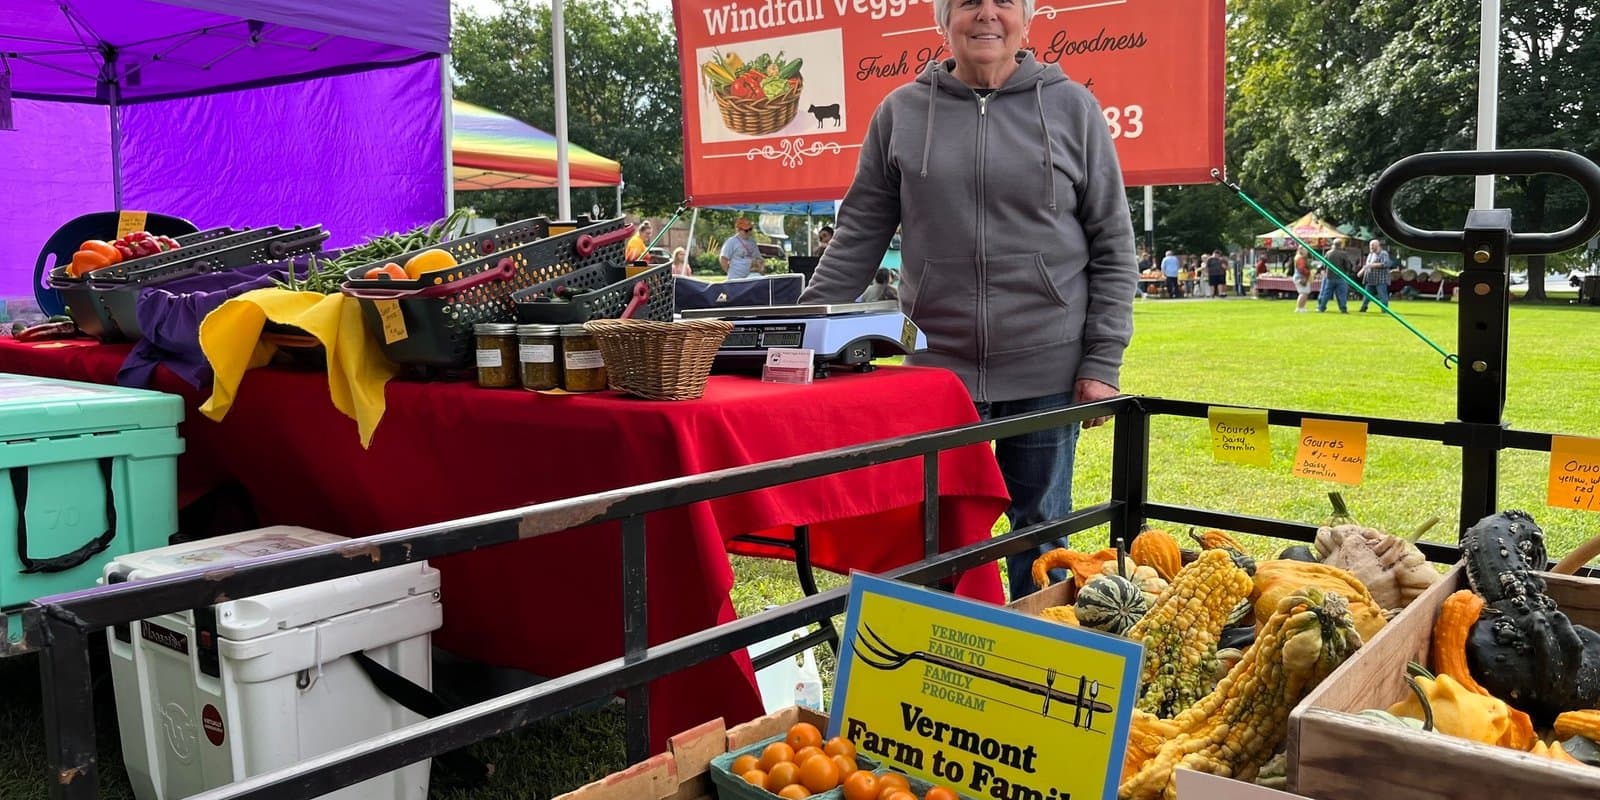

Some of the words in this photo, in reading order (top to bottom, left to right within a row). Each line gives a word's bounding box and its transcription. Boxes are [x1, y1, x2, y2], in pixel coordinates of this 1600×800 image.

[703, 0, 825, 36] Windfall
[834, 0, 933, 20] Vegg
[856, 50, 909, 81] Fresh
[1044, 27, 1147, 63] Goodness
[1215, 422, 1256, 435] Gourds
[1222, 435, 1245, 444] Daisy
[1302, 435, 1344, 449] Gourds
[1222, 443, 1255, 451] Gremlin
[1303, 460, 1327, 471] Daisy
[1342, 455, 1362, 464] each
[1302, 468, 1337, 478] Gremlin
[1558, 475, 1588, 486] yellow,
[1575, 485, 1594, 493] red
[1573, 495, 1581, 505] 4
[931, 624, 997, 652] VERMONT
[928, 640, 964, 662] FARM
[968, 651, 985, 668] TO
[924, 665, 974, 690] FAMILY
[920, 682, 986, 712] PROGRAM
[900, 702, 1038, 773] Vermont
[847, 717, 924, 771] Farm
[931, 750, 963, 787] to
[968, 760, 1073, 800] Fam
